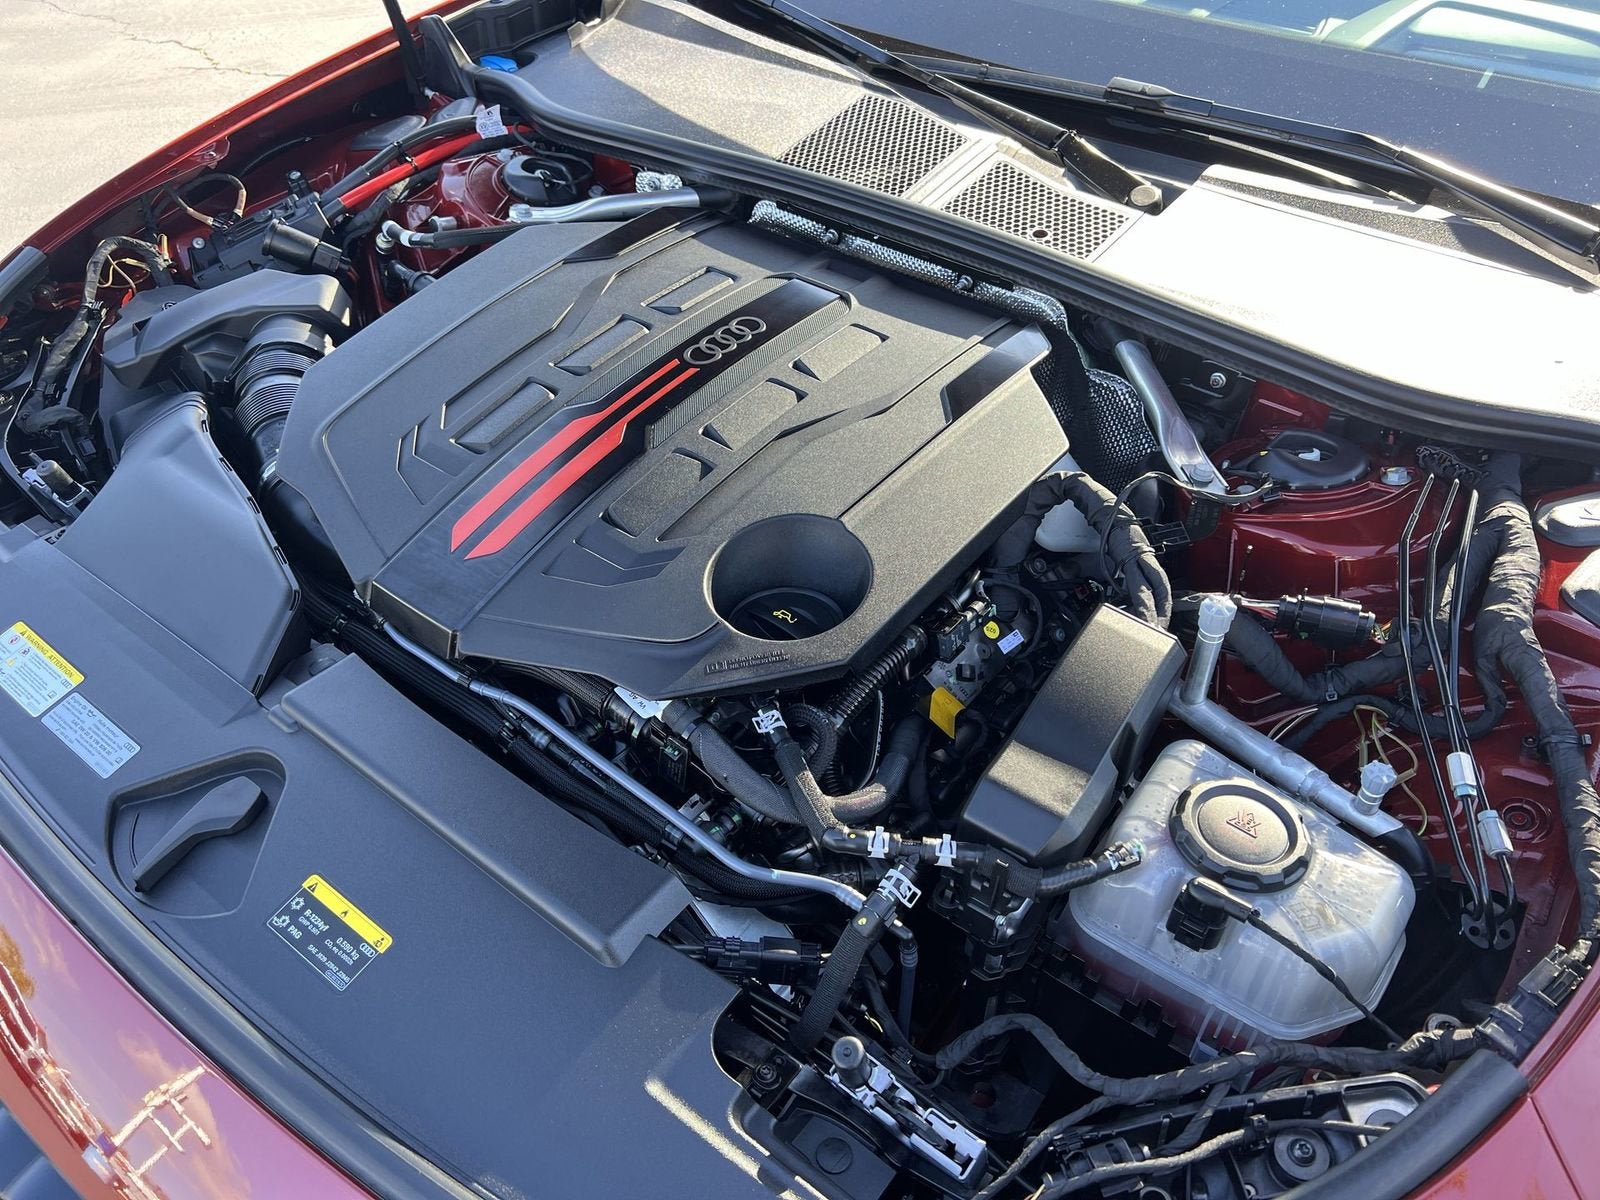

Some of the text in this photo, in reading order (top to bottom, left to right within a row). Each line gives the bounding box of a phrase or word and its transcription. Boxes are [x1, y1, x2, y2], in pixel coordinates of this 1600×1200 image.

[25, 634, 49, 655] WARNING
[47, 653, 74, 678] ATTENTION
[304, 909, 329, 932] R-1234yf
[287, 925, 302, 939] PAG
[307, 944, 318, 954] SAE
[351, 949, 360, 960] kg
